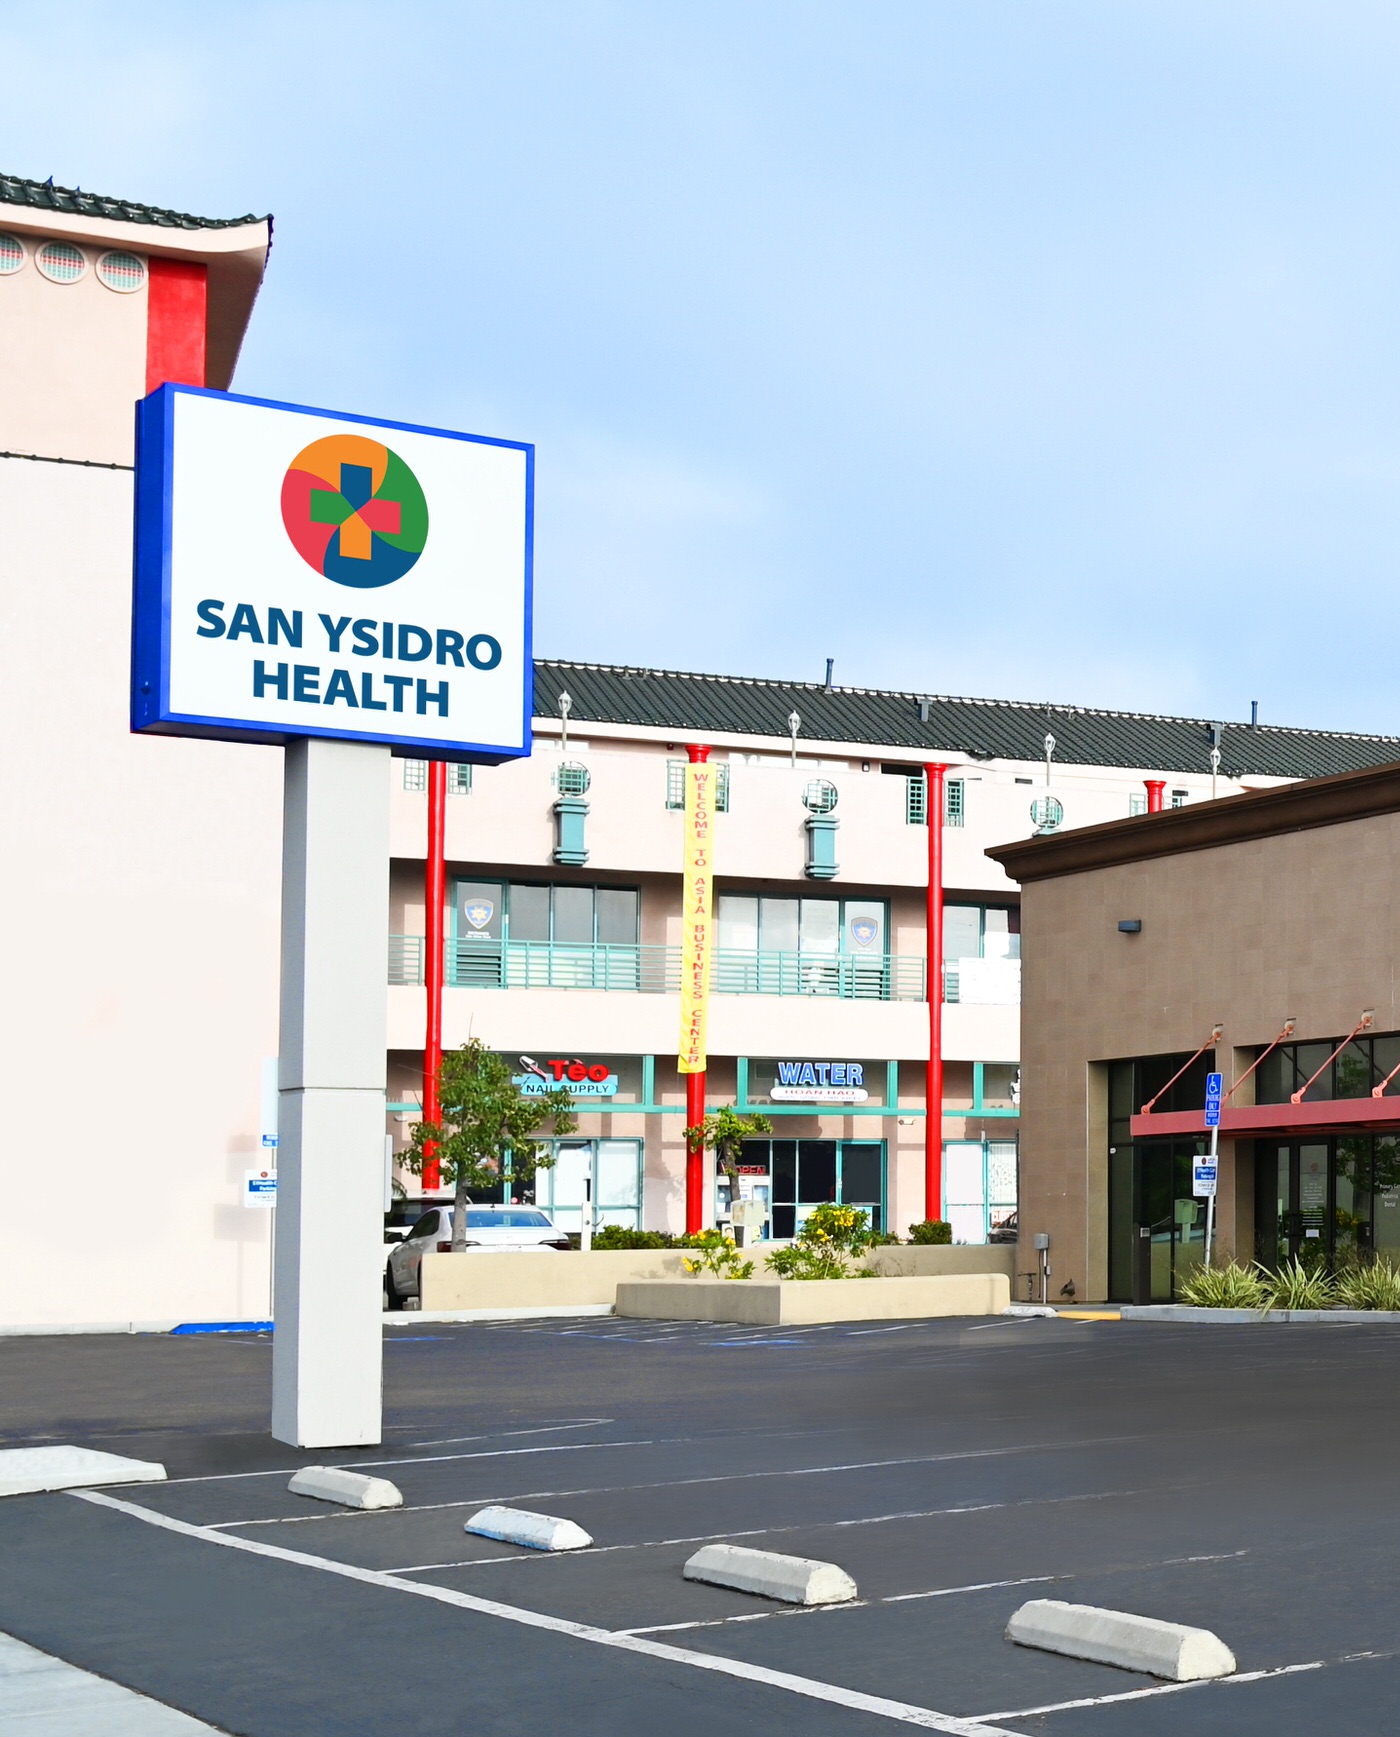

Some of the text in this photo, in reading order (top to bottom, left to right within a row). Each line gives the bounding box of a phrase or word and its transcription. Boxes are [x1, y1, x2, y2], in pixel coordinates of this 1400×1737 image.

[196, 598, 503, 671] SAN YSIDRO
[252, 660, 450, 718] HEALTH
[688, 773, 709, 1064] WELCOME TO ASIA BUSINESS CENTER
[526, 1084, 556, 1094] NAIL
[778, 1062, 863, 1085] WATER
